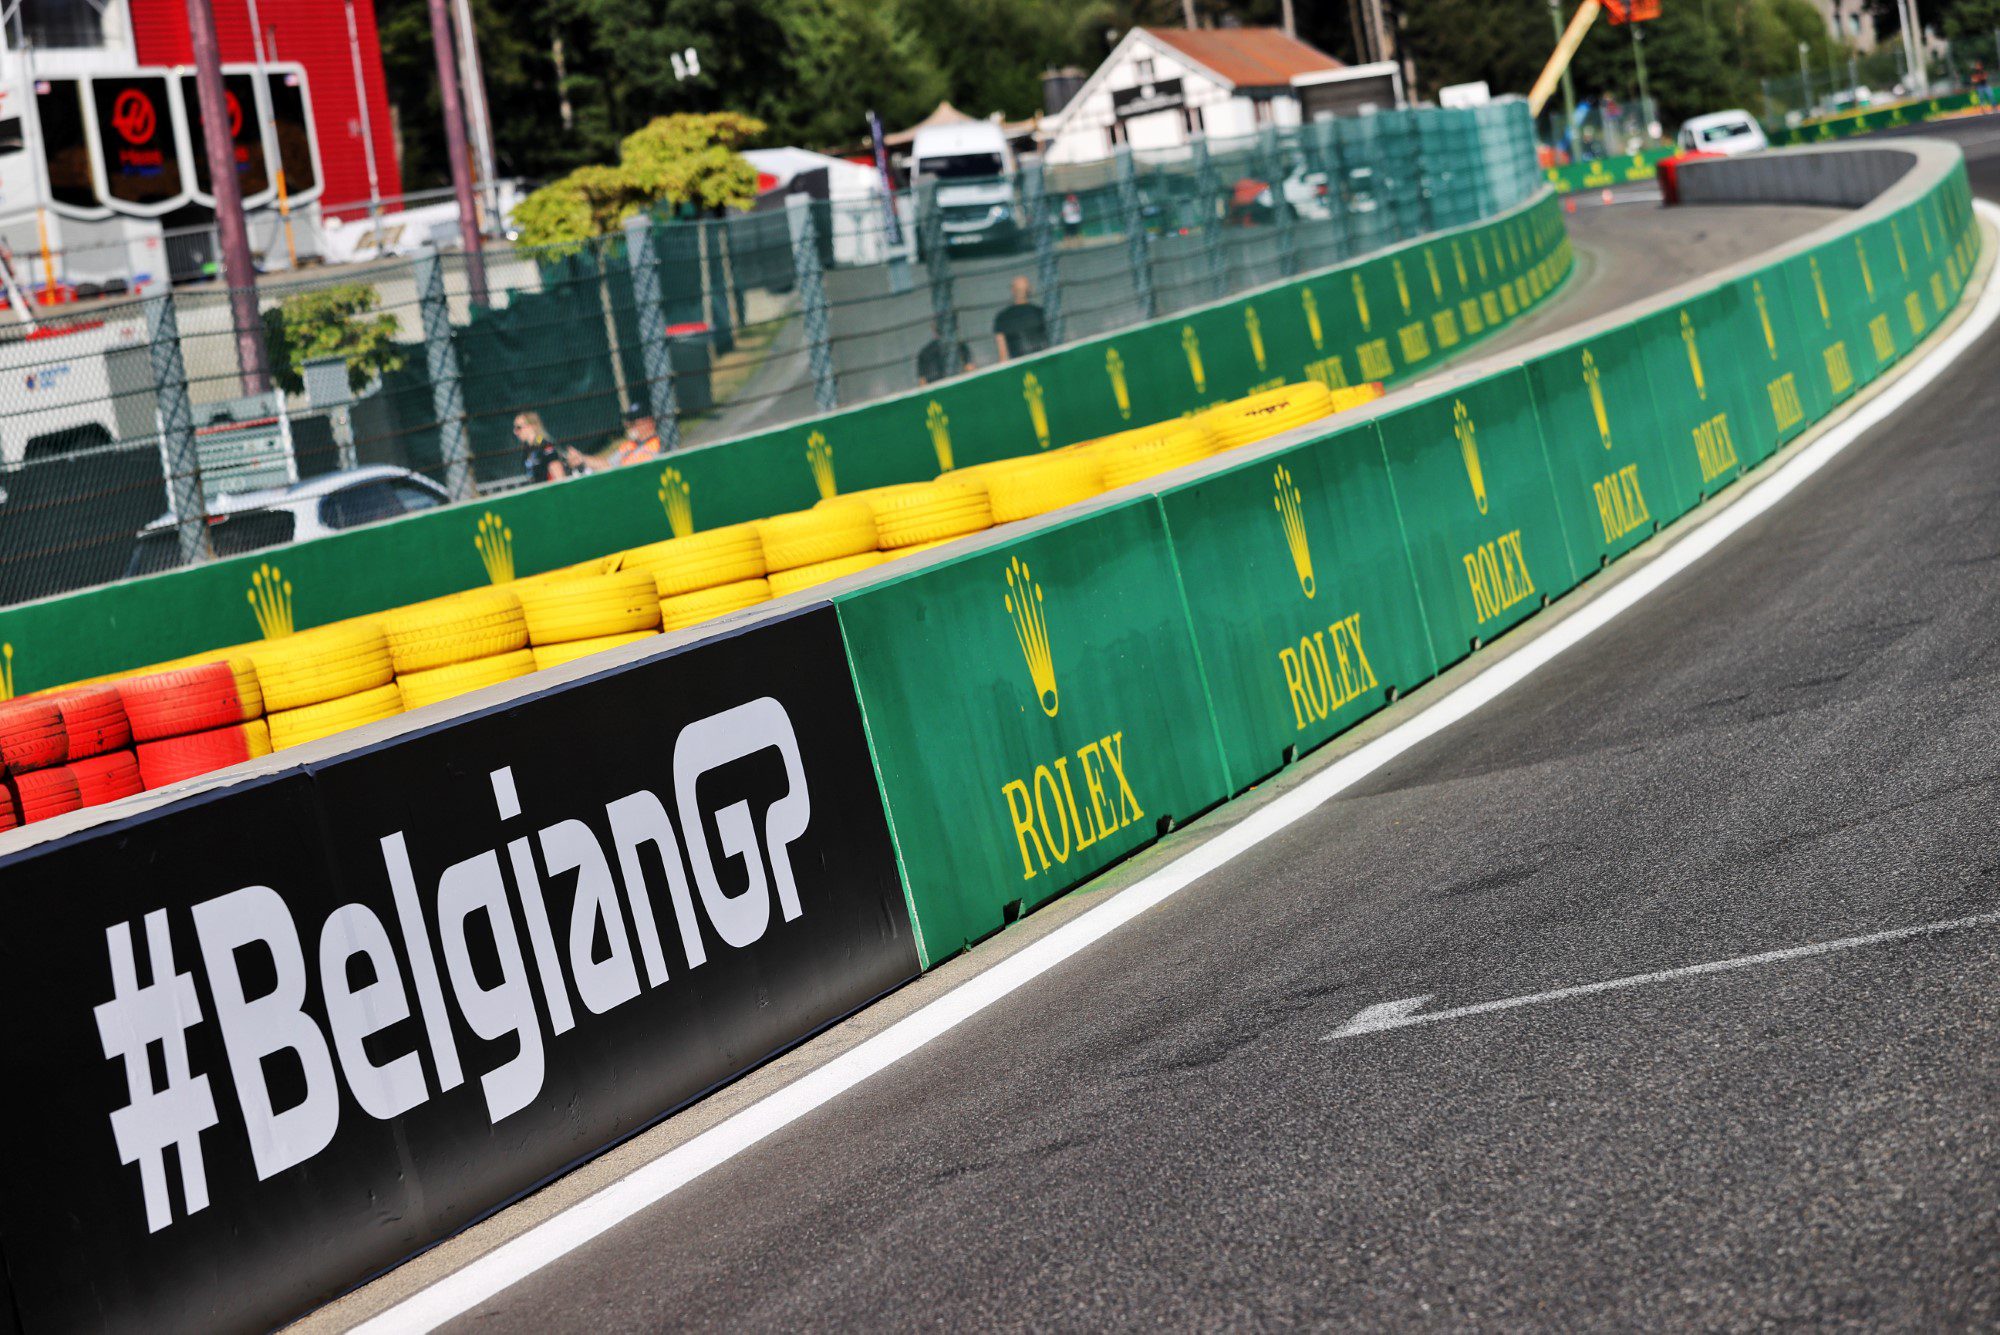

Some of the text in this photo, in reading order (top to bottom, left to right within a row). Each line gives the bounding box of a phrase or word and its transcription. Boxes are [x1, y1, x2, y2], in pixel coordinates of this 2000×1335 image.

[1593, 463, 1650, 544] ROLEX
[1463, 530, 1535, 623] ROLEX
[1279, 613, 1378, 731] ROLEX
[1002, 731, 1144, 880] ROLEX
[94, 696, 810, 1233] #BelgianGP
